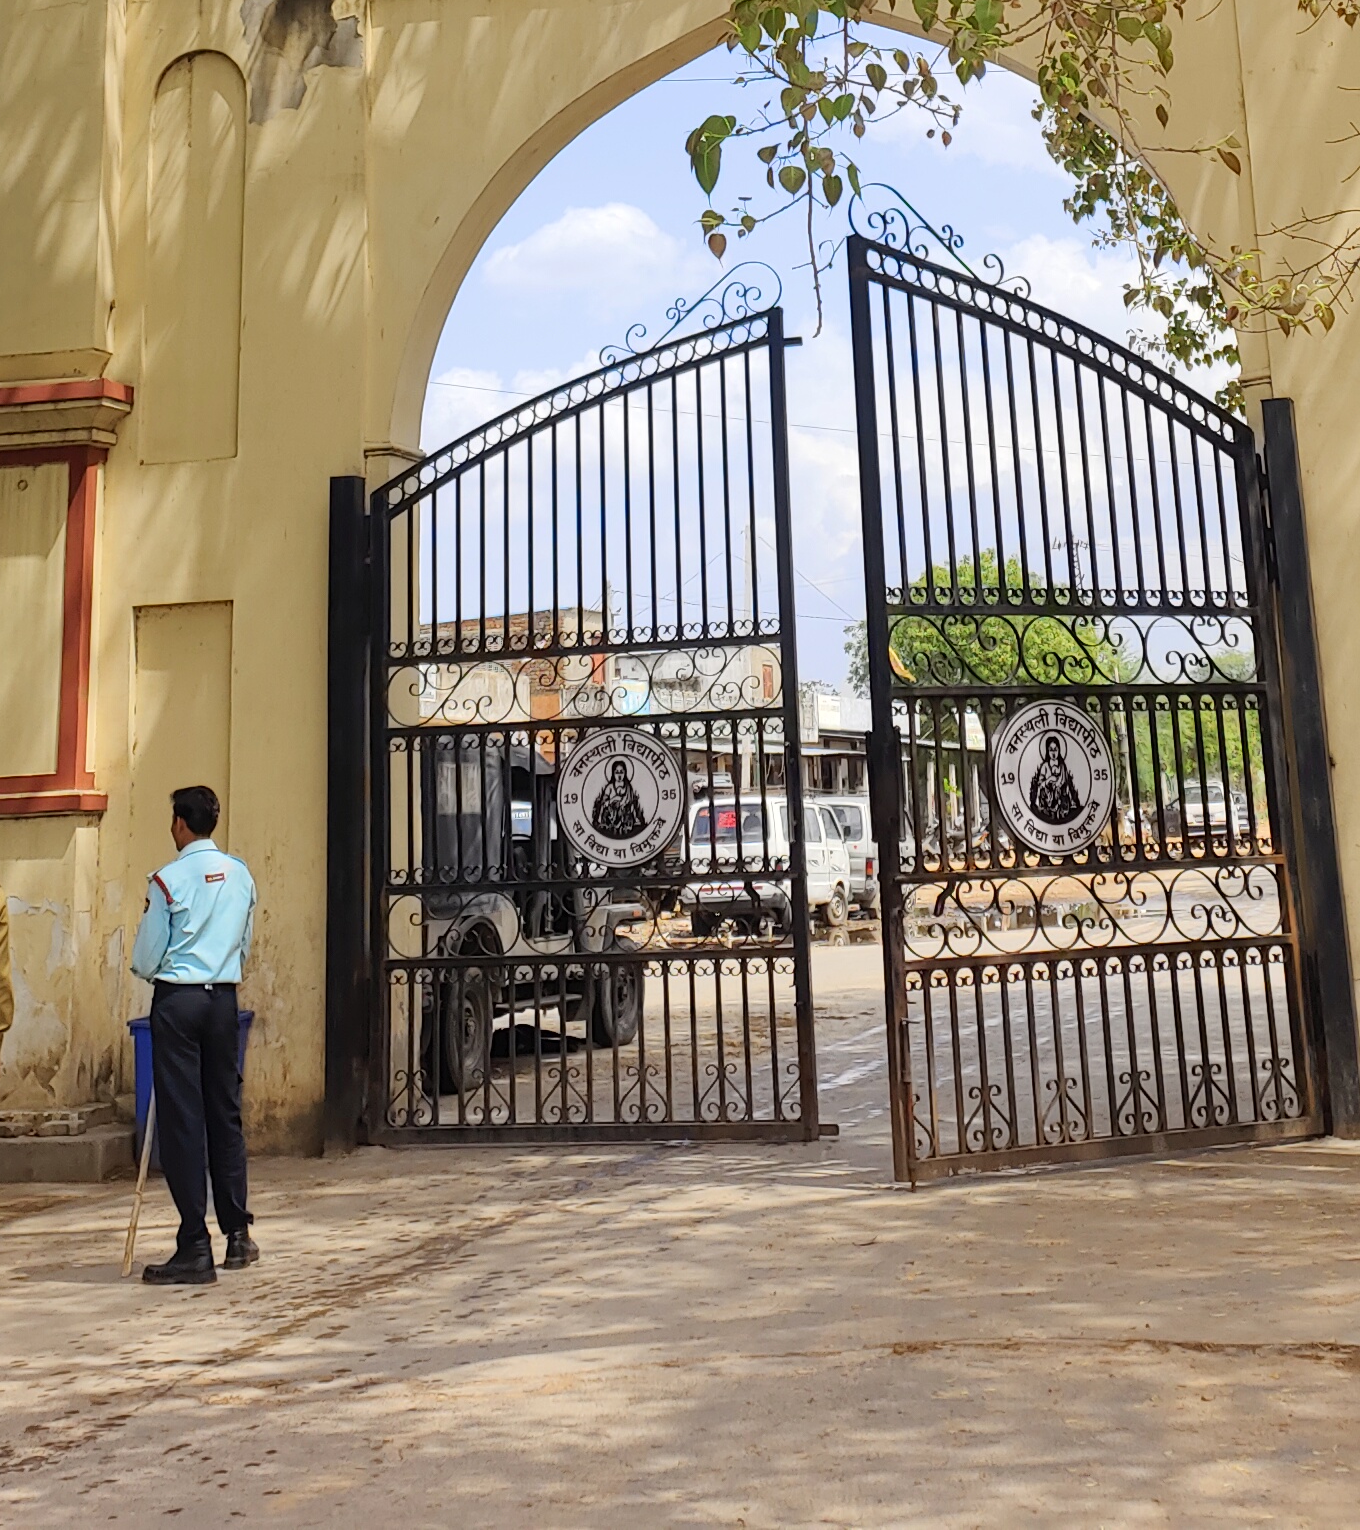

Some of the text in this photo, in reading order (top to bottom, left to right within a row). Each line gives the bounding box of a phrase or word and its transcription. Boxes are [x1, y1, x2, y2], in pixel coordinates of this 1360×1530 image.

[1005, 707, 1102, 759] वनस्थली विद्यापीठ
[569, 733, 671, 780] वनस्थली विद्यापीठ
[1001, 772, 1015, 785] 19
[1093, 769, 1108, 780] 35
[563, 793, 578, 804] 19
[661, 789, 677, 800] 35
[1011, 801, 1024, 822] सा
[1024, 819, 1047, 844] विद्या
[1052, 835, 1065, 846] या
[572, 819, 586, 838] सा
[584, 835, 609, 857] विद्या
[613, 848, 627, 859] या
